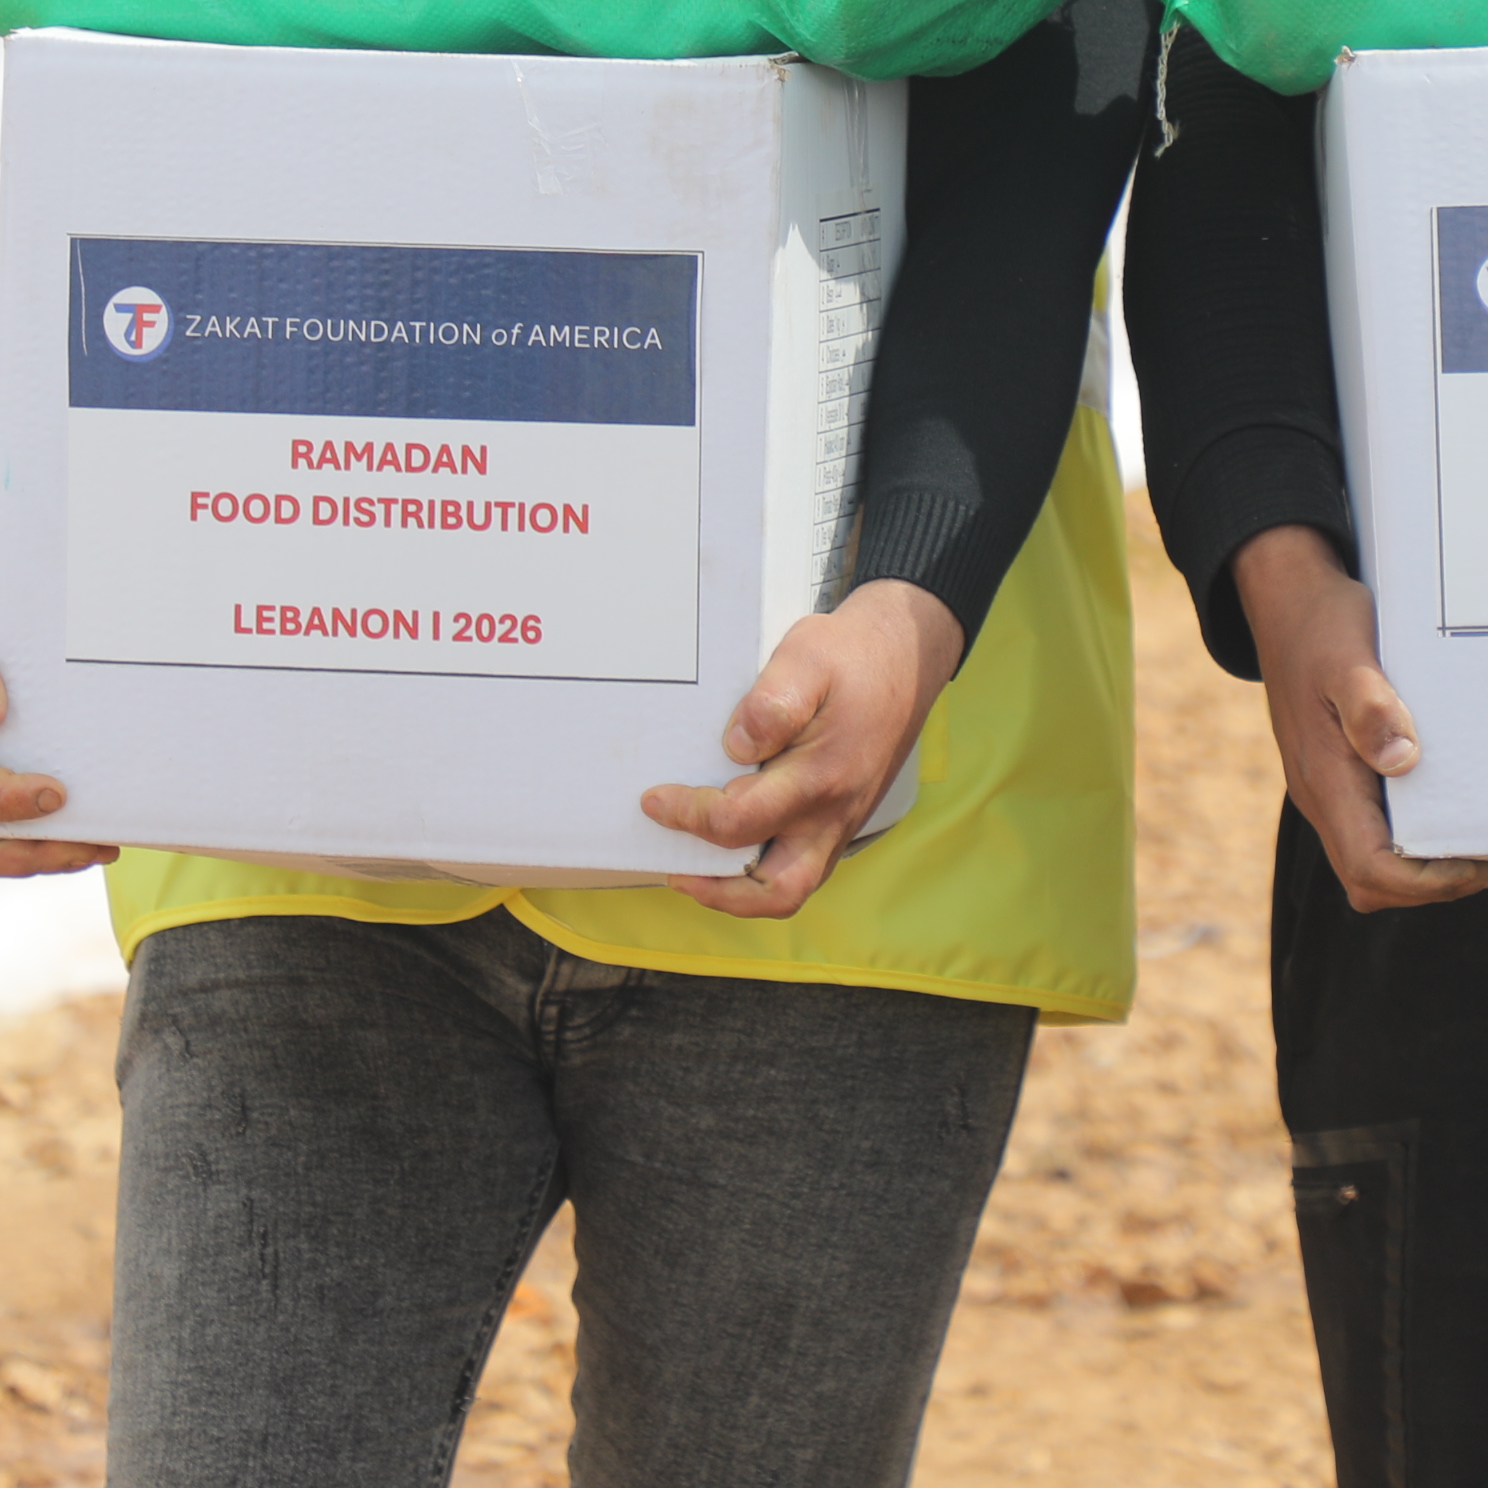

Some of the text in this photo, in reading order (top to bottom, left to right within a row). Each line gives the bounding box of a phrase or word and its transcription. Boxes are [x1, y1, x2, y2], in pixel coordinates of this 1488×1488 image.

[185, 314, 663, 350] ZAKAT FOUNDATION of AMERICA
[290, 438, 488, 476] RAMADAN
[189, 490, 590, 535] FOOD DISTRIBUTION
[233, 603, 421, 640] LEBANON
[452, 611, 544, 645] 2026
